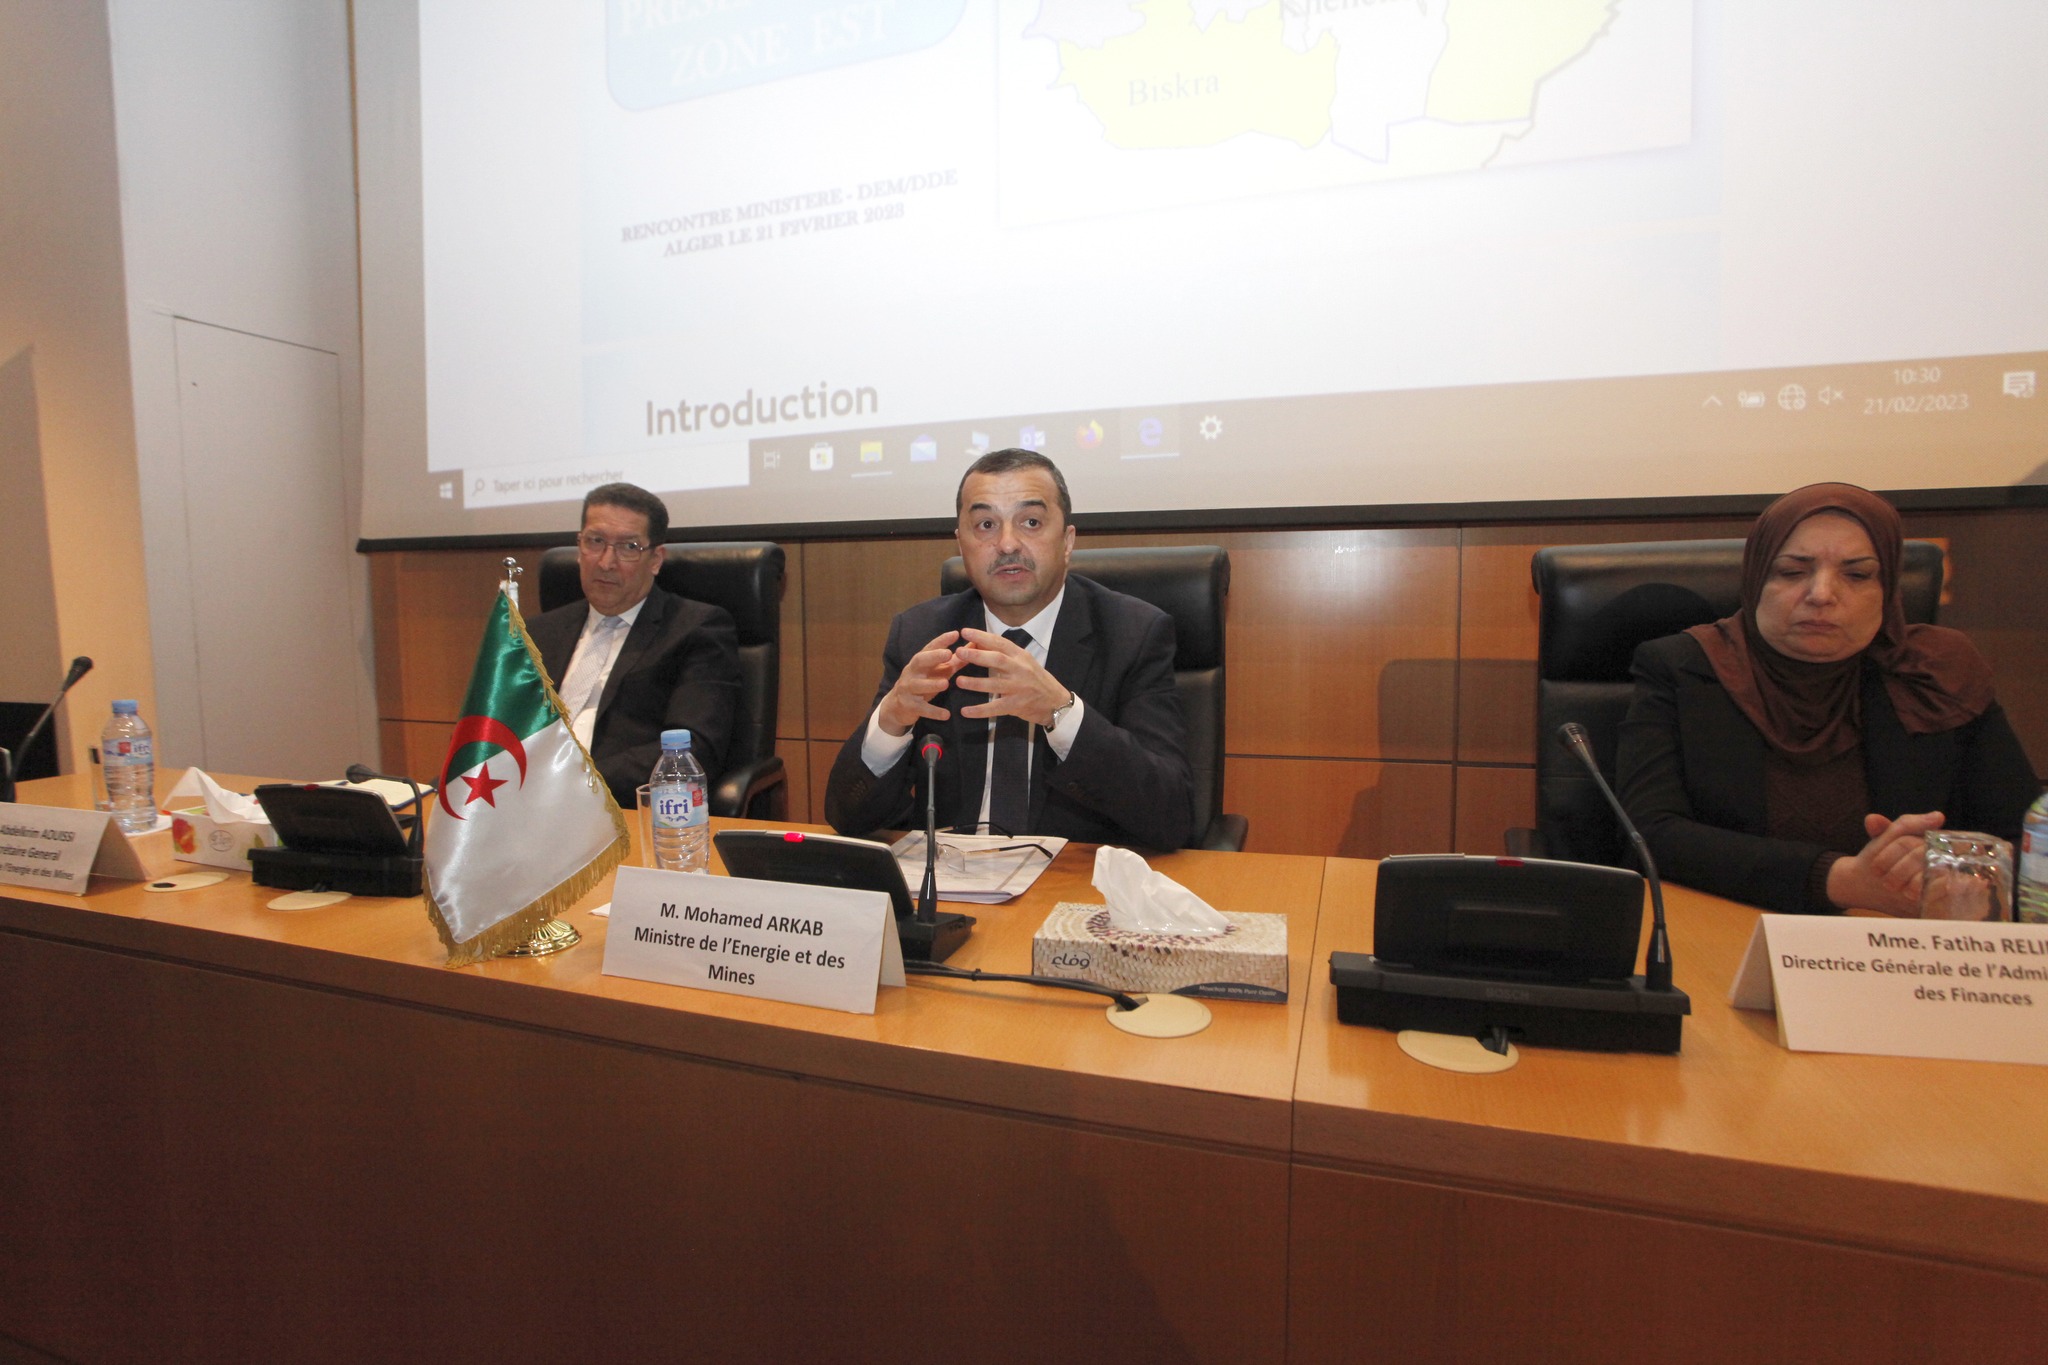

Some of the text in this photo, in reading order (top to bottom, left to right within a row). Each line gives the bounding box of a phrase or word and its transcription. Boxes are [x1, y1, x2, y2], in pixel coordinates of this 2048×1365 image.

[669, 2, 889, 87] ZONE EST
[1128, 72, 1220, 107] Biskra
[621, 207, 732, 243] RENCONTRE
[736, 188, 844, 221] MINISTERE
[857, 169, 959, 201] DEM/DDE
[663, 232, 724, 257] ALGER
[729, 228, 753, 245] LE
[756, 224, 774, 242] 21
[864, 203, 906, 225] 2023
[1893, 366, 1941, 385] 10:30
[645, 382, 879, 437] Introduction
[1863, 393, 1969, 416] 21/02/2023
[494, 470, 624, 494] Taper ici pour rechercher
[659, 799, 689, 815] ifri
[660, 902, 824, 937] M. Mohamed ARKAB
[634, 926, 695, 950] Ministre
[699, 934, 718, 952] de
[795, 948, 812, 965] et
[816, 950, 845, 969] des
[1867, 932, 2048, 955] Mme. Fatiha RELI
[708, 964, 755, 986] Mines
[1781, 954, 1866, 972] Directrice
[1870, 958, 1952, 977] Générale
[1958, 962, 1981, 977] de
[1914, 985, 2033, 1005] des Finances
